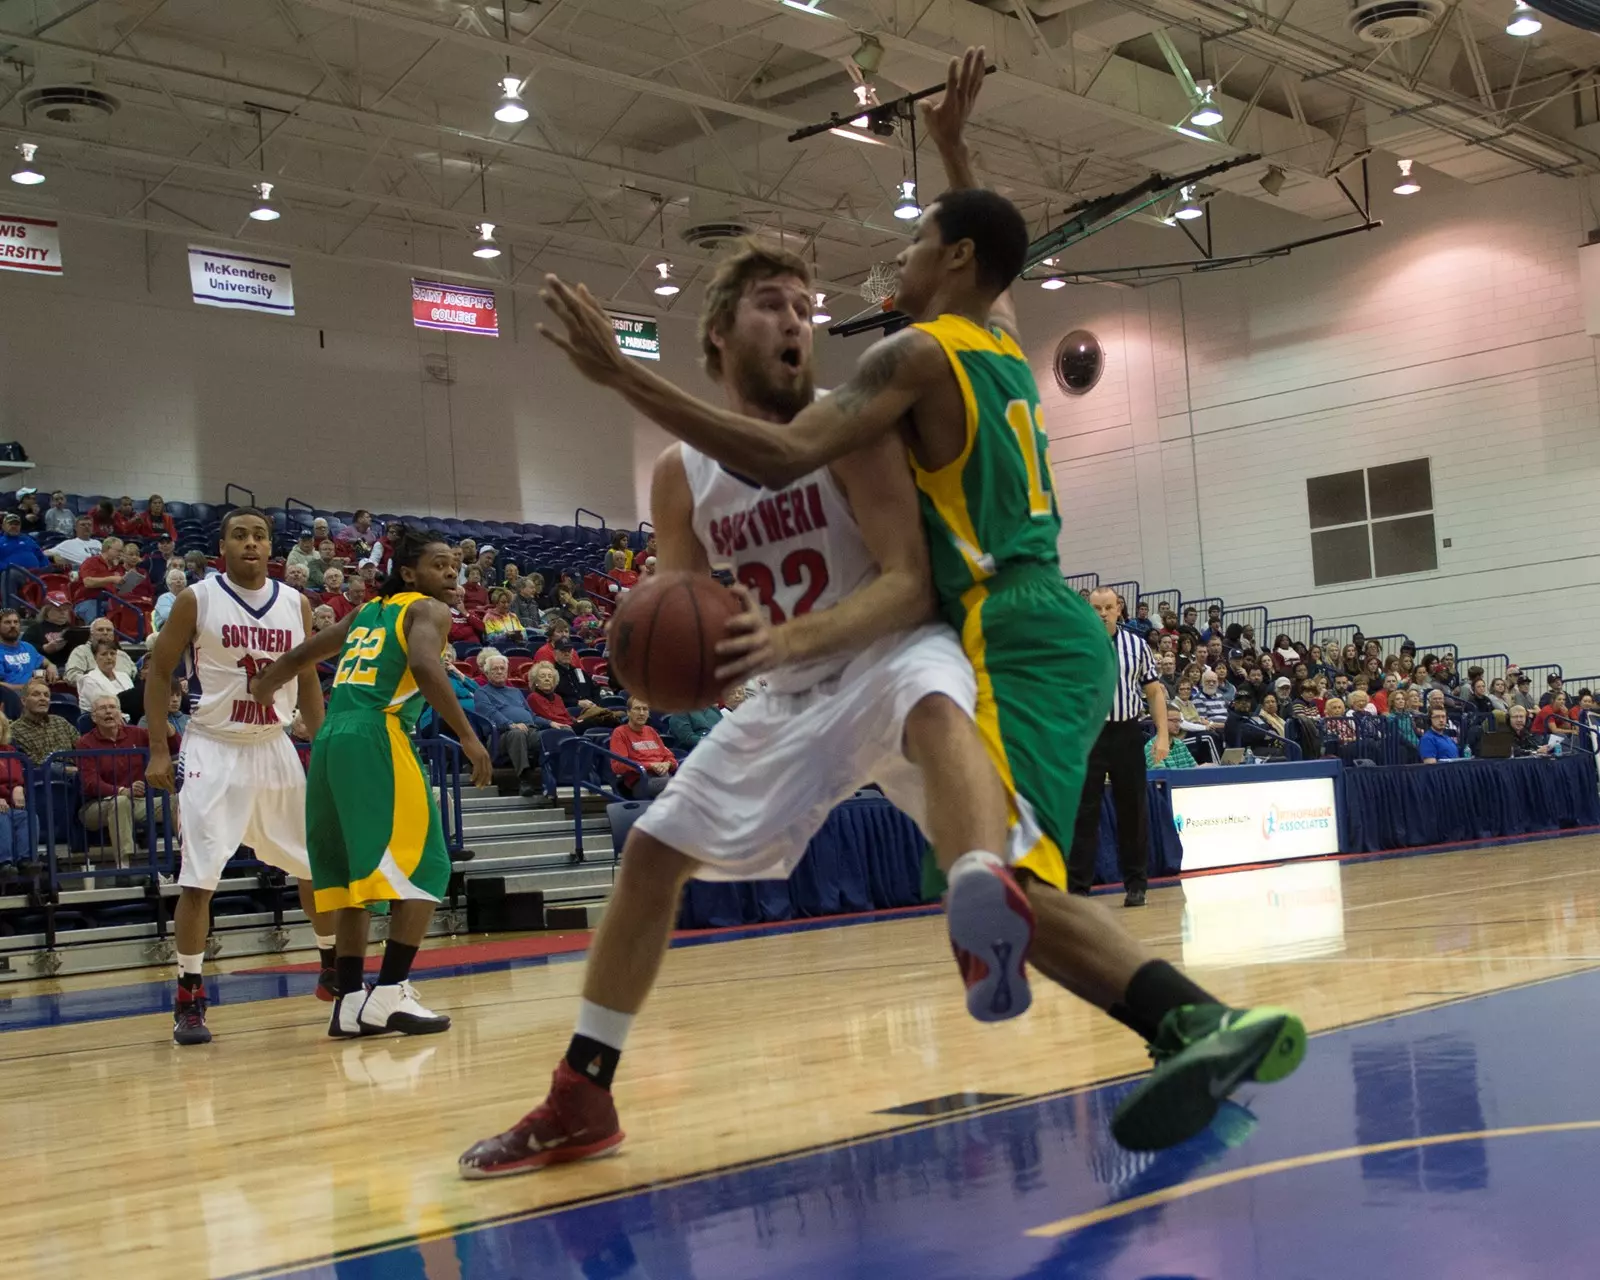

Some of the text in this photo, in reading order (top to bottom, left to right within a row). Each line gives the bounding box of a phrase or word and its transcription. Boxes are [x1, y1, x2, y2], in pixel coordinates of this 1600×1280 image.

[204, 262, 277, 283] McKendree
[209, 278, 273, 299] University
[412, 287, 495, 310] SAINT JOSEPH'S
[430, 307, 477, 326] COLLEGE
[634, 322, 644, 333] OF
[625, 336, 657, 351] PARKSIDE
[1005, 399, 1062, 517] 1
[221, 624, 292, 653] SOUTHERN
[333, 626, 386, 687] 22
[237, 653, 275, 695] 1
[1279, 818, 1329, 832] ASSOCIATES
